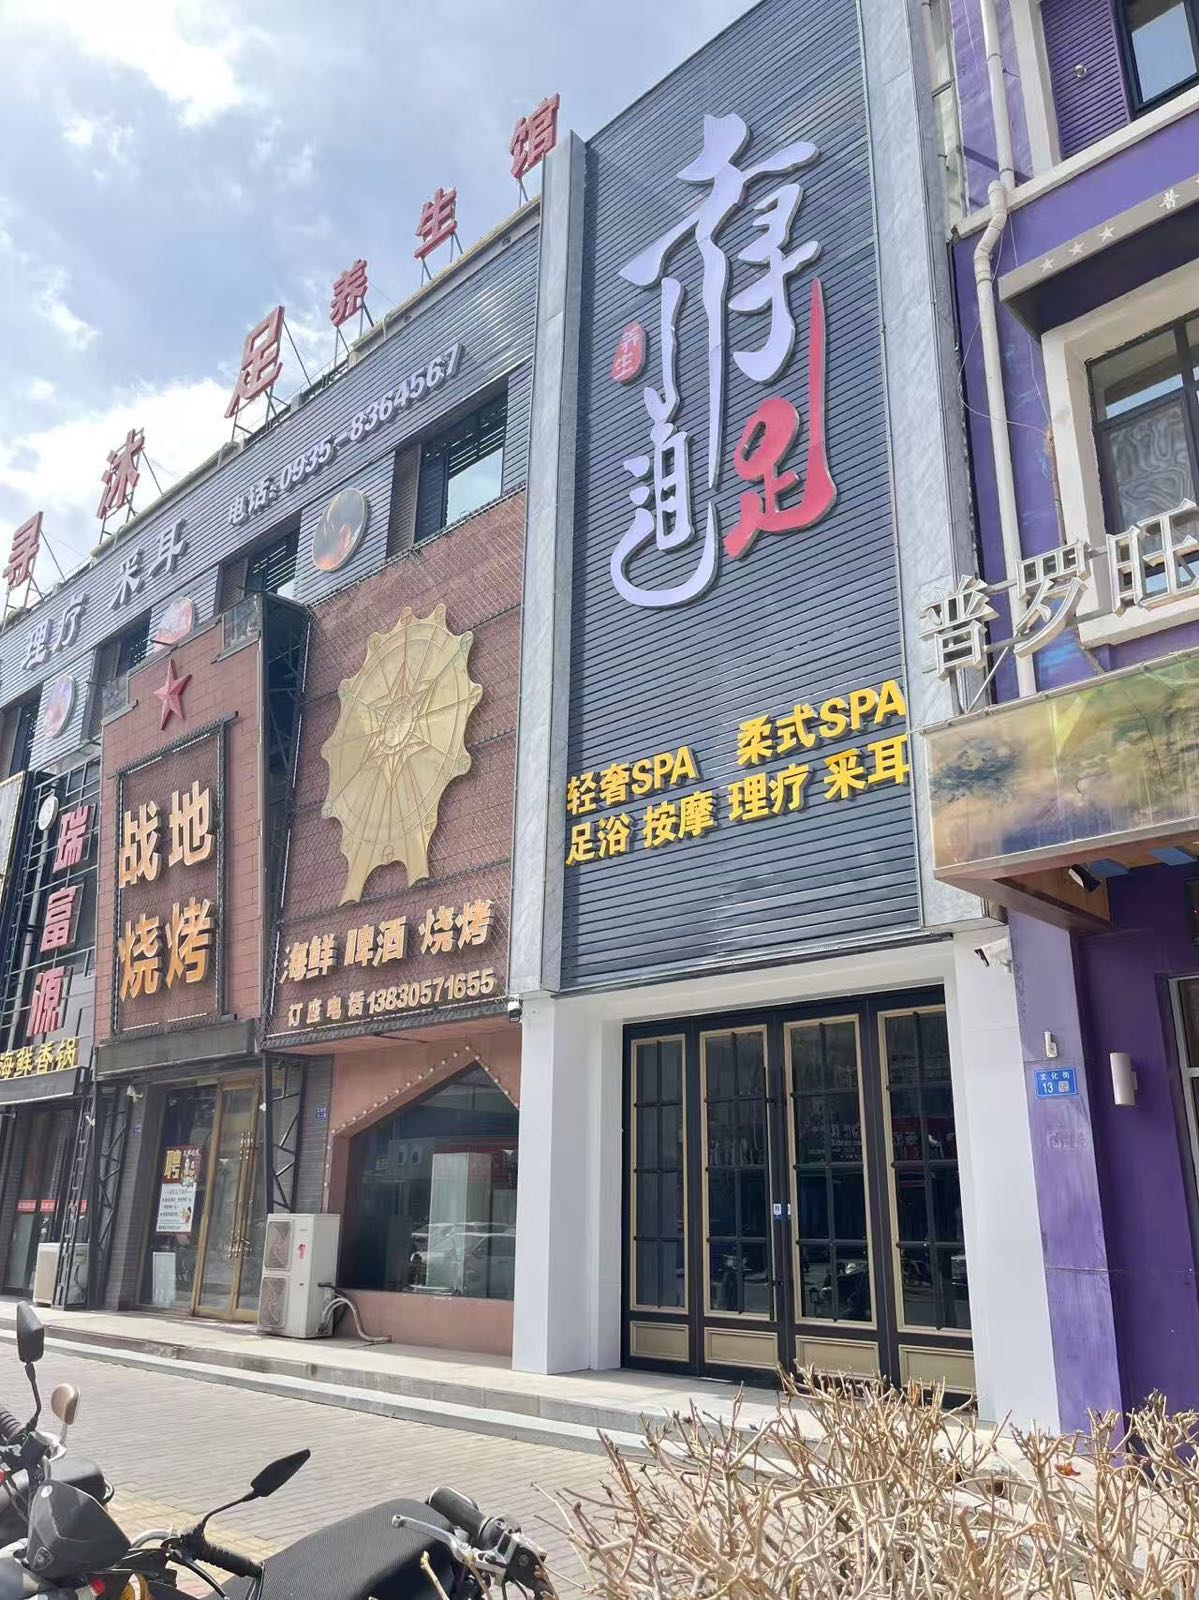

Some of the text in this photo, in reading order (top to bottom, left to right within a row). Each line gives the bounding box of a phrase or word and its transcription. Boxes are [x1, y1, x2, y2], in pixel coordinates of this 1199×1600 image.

[22, 518, 189, 671] 理疗 采耳
[565, 735, 910, 866] 足浴 按摩 理疗 采耳
[567, 680, 908, 816] 轻奢SPA 柔式SPA
[119, 781, 216, 889] 战地
[26, 805, 91, 1037] 瑞富源
[119, 897, 214, 1001] 烧烤
[279, 899, 494, 984] 海鲜 啤酒 烧烤
[0, 1038, 78, 1080] 海鲜香锅
[1042, 1082, 1054, 1093] 13
